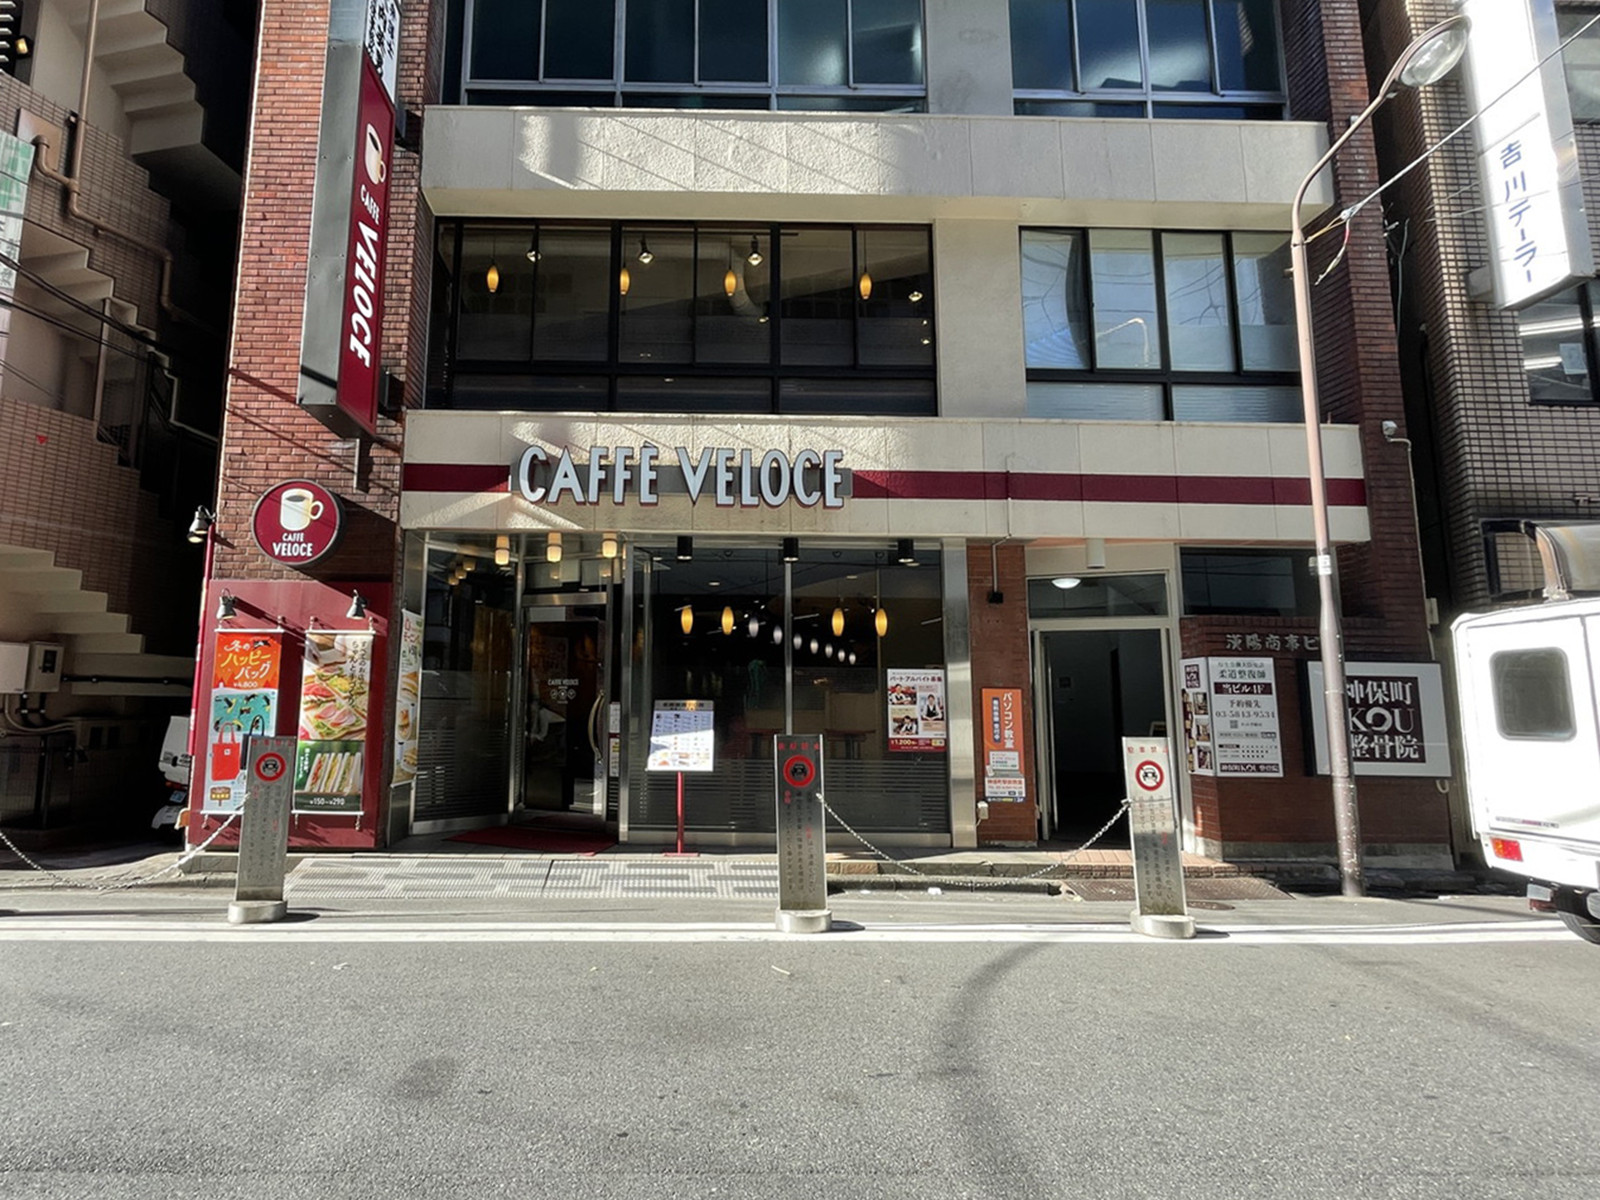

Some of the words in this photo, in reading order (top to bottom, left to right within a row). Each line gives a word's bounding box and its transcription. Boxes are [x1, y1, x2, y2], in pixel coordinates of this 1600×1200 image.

[1500, 140, 1537, 282] 吉川テーラー
[350, 221, 378, 368] VELOCE
[675, 446, 845, 509] VELOCE
[272, 542, 313, 557] VELOCE
[220, 650, 271, 667] ハッピー
[234, 661, 272, 679] バッグ
[1347, 680, 1412, 705] 神保町
[1003, 692, 1014, 749] パソコン教室
[1348, 707, 1415, 733] KOU
[1350, 734, 1419, 759] 整骨院
